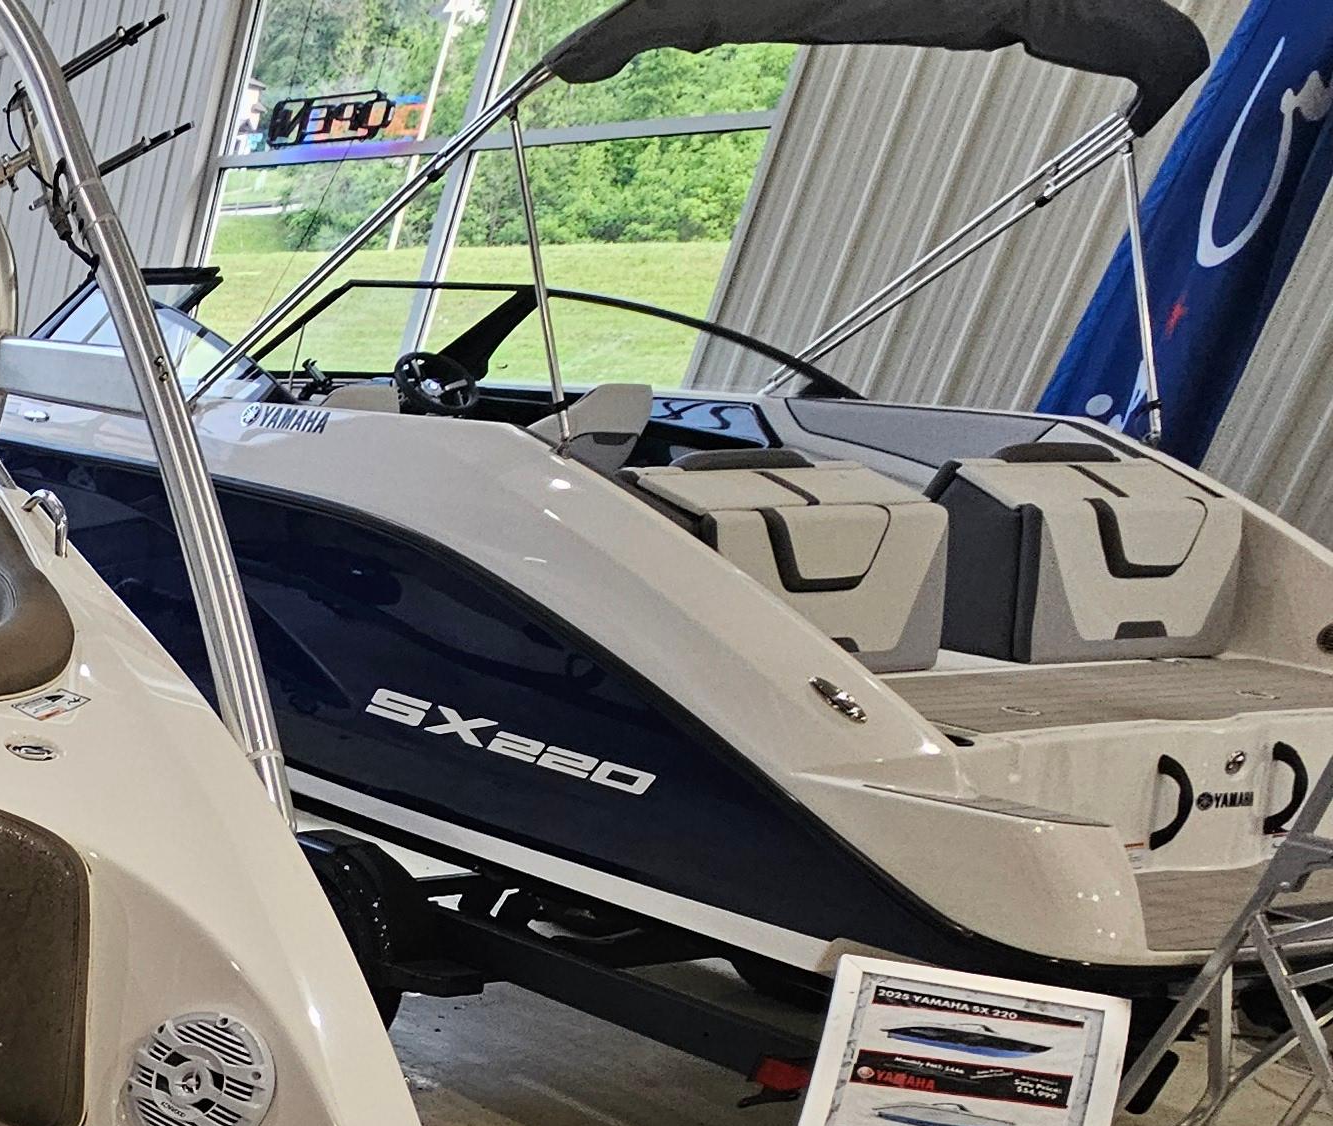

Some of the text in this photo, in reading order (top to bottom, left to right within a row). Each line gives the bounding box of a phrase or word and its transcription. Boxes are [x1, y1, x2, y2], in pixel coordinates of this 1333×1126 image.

[259, 405, 331, 434] YAMAHA
[877, 988, 1019, 1020] 2025 YAMAHA SX 220
[875, 1069, 937, 1091] YAMAHA
